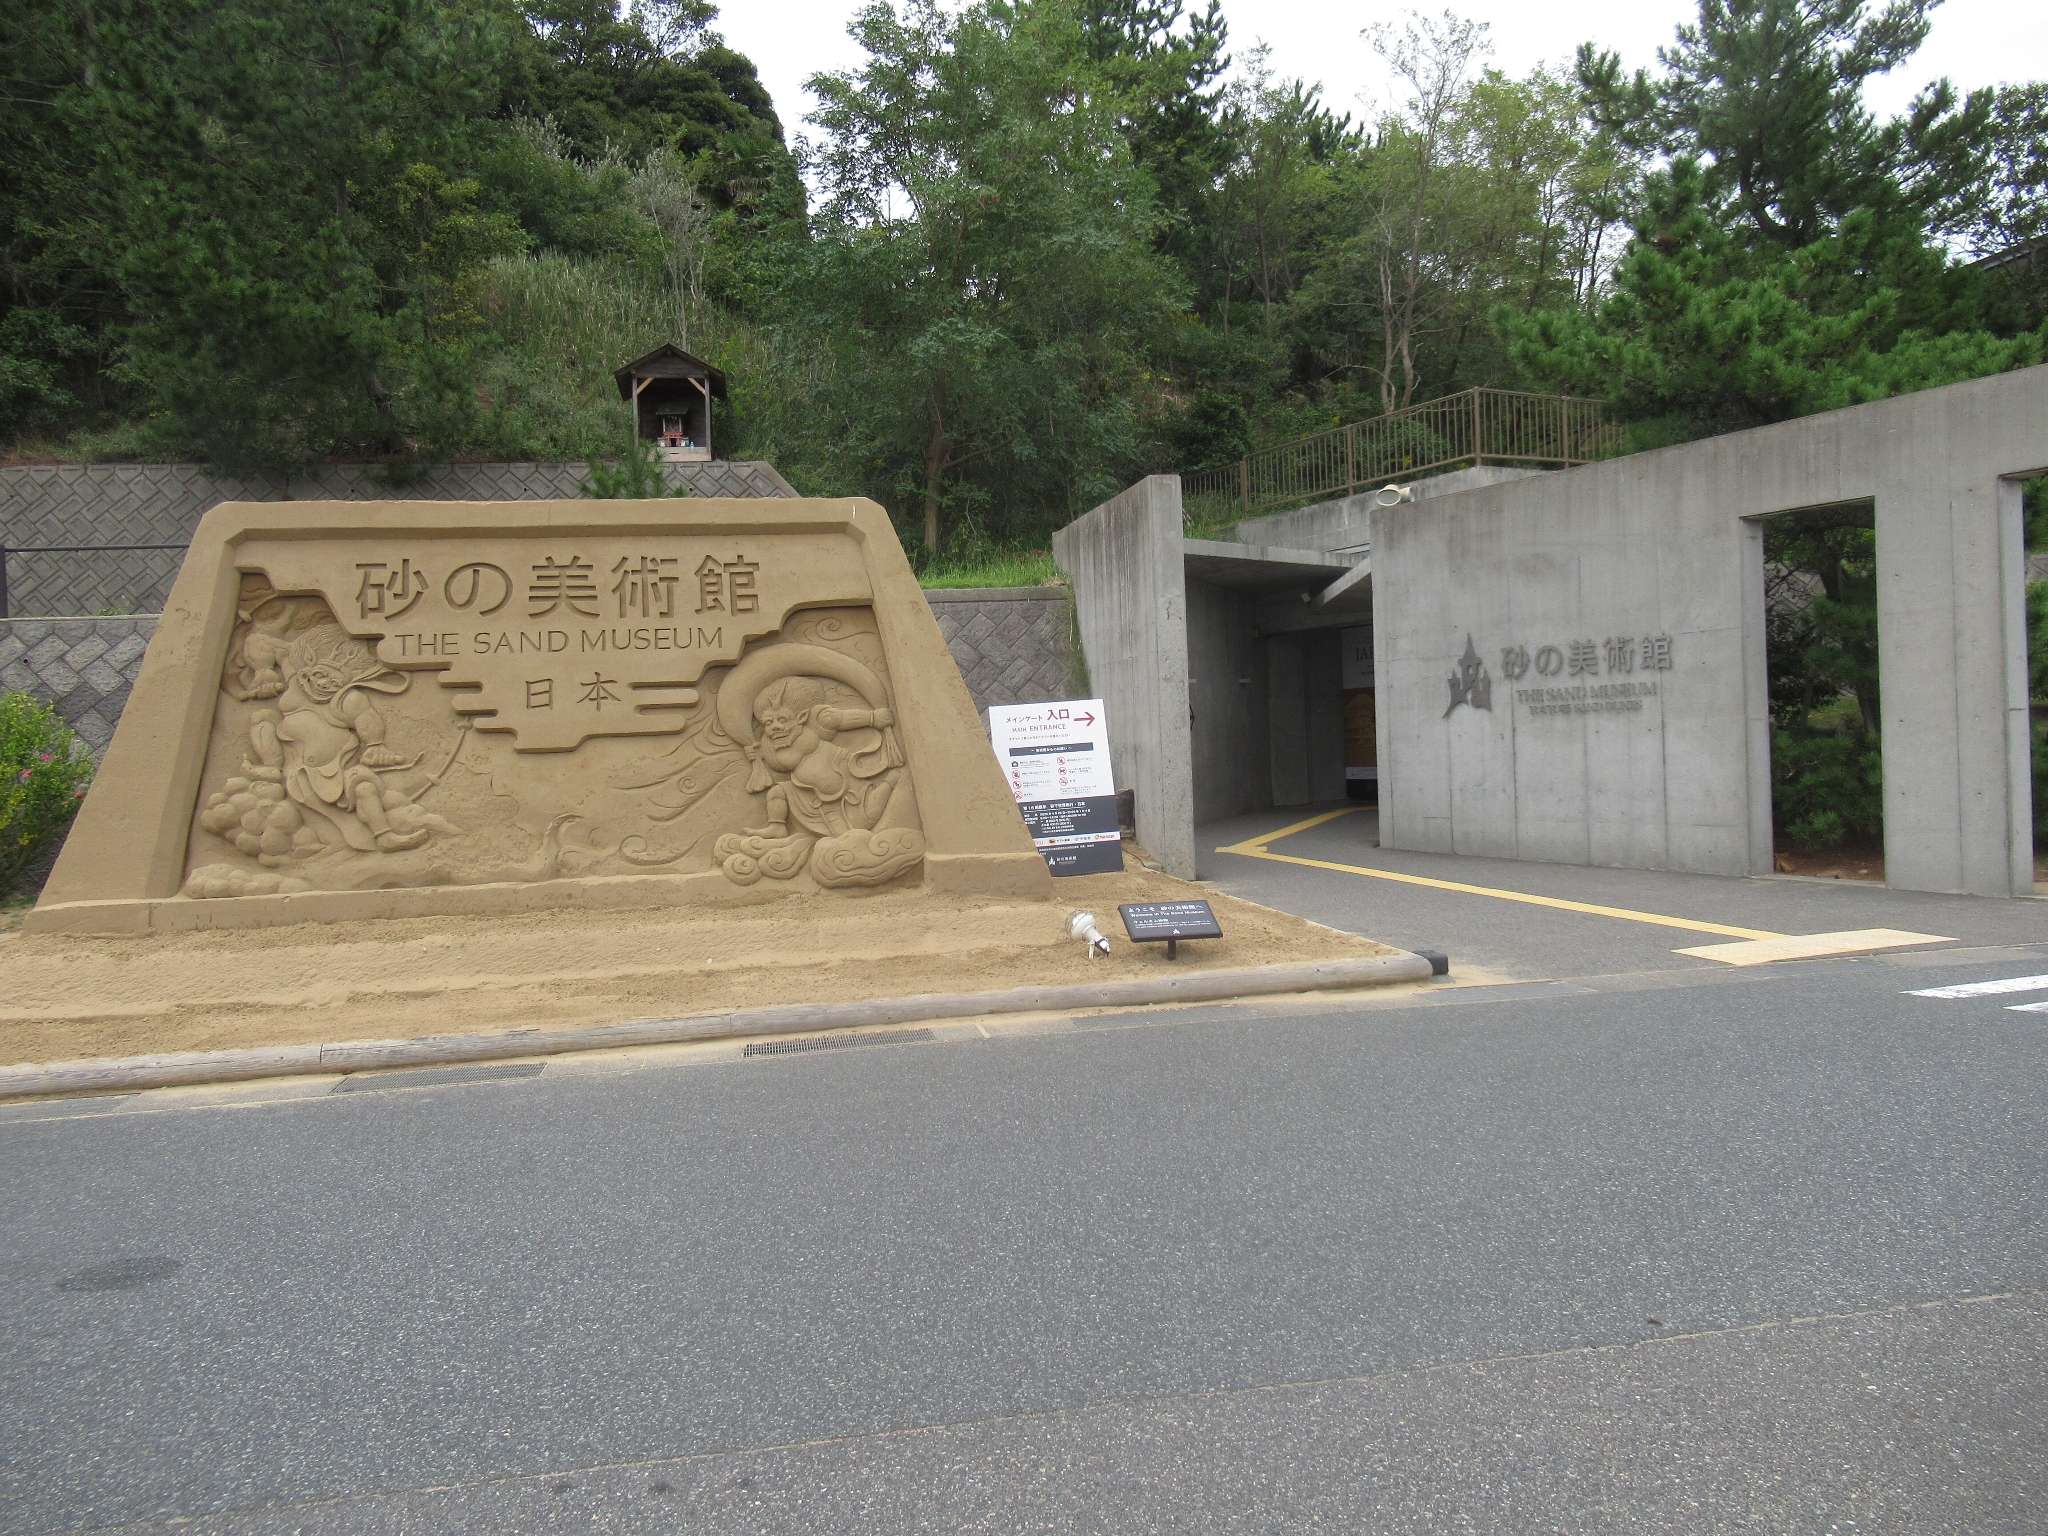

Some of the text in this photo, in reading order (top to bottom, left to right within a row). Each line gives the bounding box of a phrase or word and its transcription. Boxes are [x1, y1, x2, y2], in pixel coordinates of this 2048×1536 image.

[354, 553, 761, 620] 砂の美術館
[395, 627, 724, 658] THE SAND MUSEUM
[1500, 633, 1673, 680] 砂の美術館
[525, 671, 622, 713] 日本
[1516, 682, 1658, 704] THE SAND MUSEUM
[1005, 708, 1070, 724] メインゲート 入口
[1029, 723, 1067, 733] ENTRANCE
